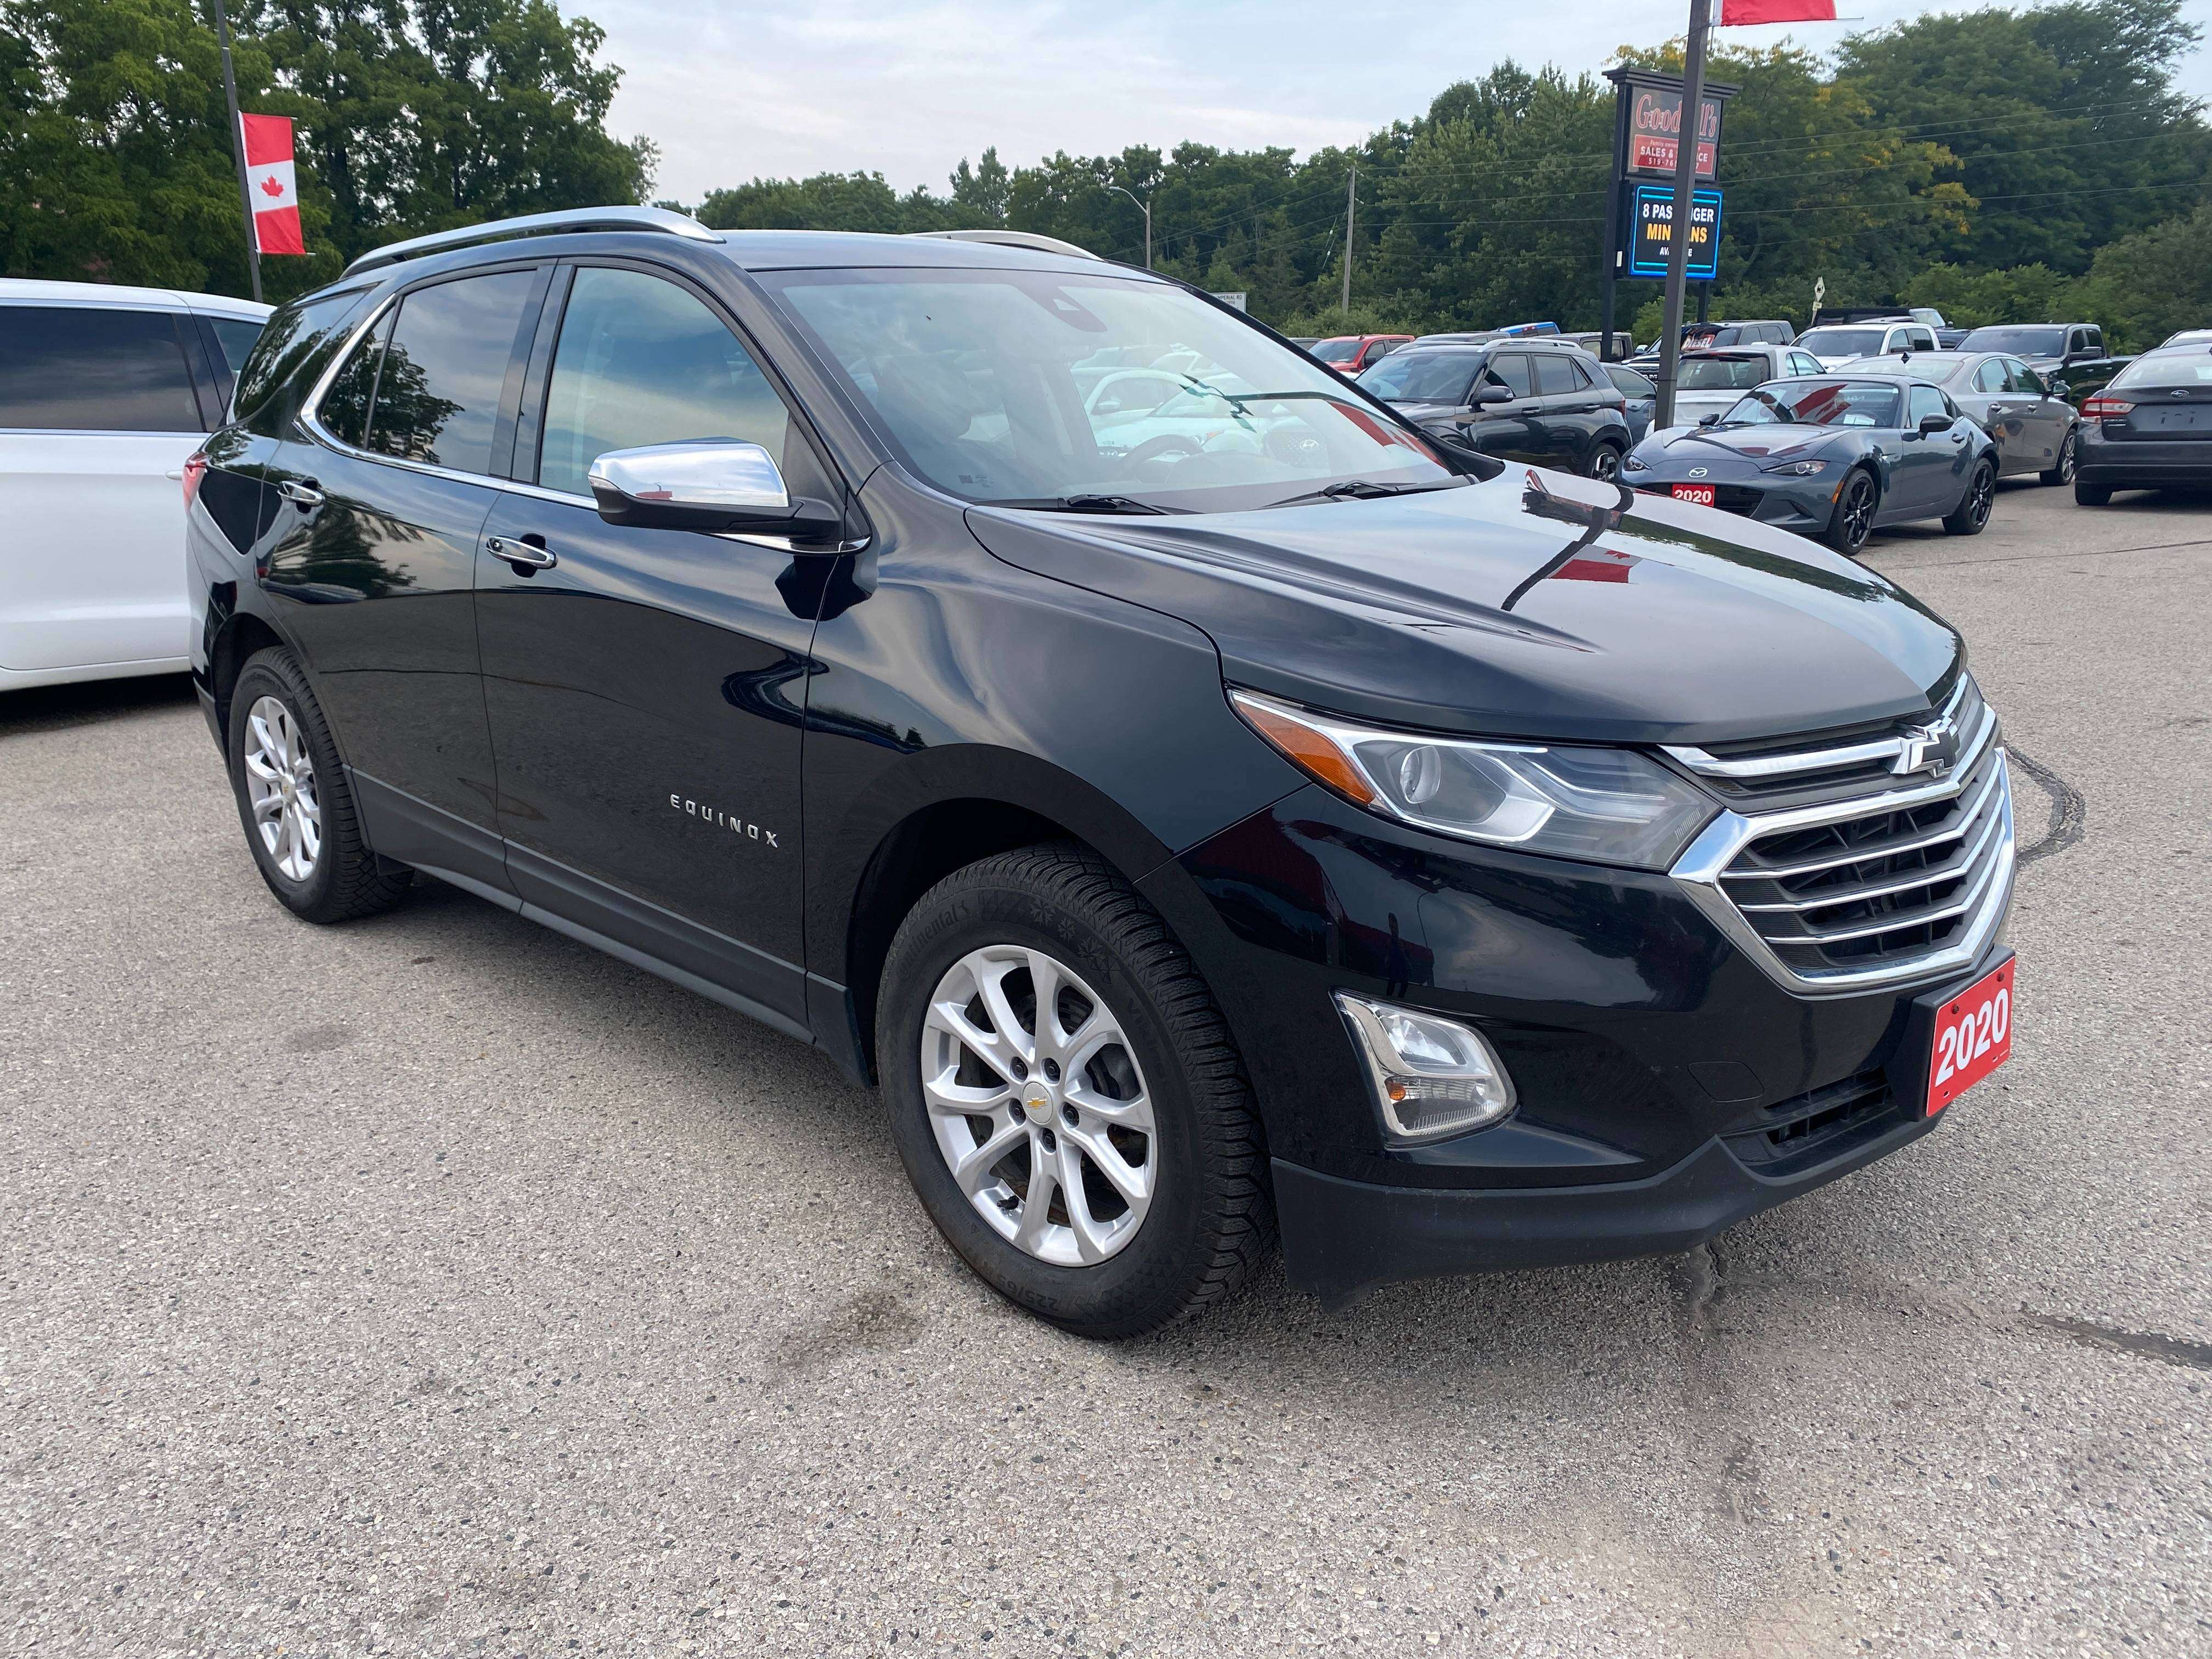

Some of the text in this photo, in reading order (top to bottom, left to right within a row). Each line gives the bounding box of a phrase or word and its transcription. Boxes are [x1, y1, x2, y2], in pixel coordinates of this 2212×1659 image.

[1640, 145, 1666, 157] SALES
[1668, 149, 1673, 159] &
[1643, 203, 1714, 222] 8 PASGER
[1646, 223, 1707, 243] MINNS
[1674, 489, 1712, 503] 2020
[670, 794, 779, 848] EQUINOX
[1935, 988, 2009, 1088] 2020
